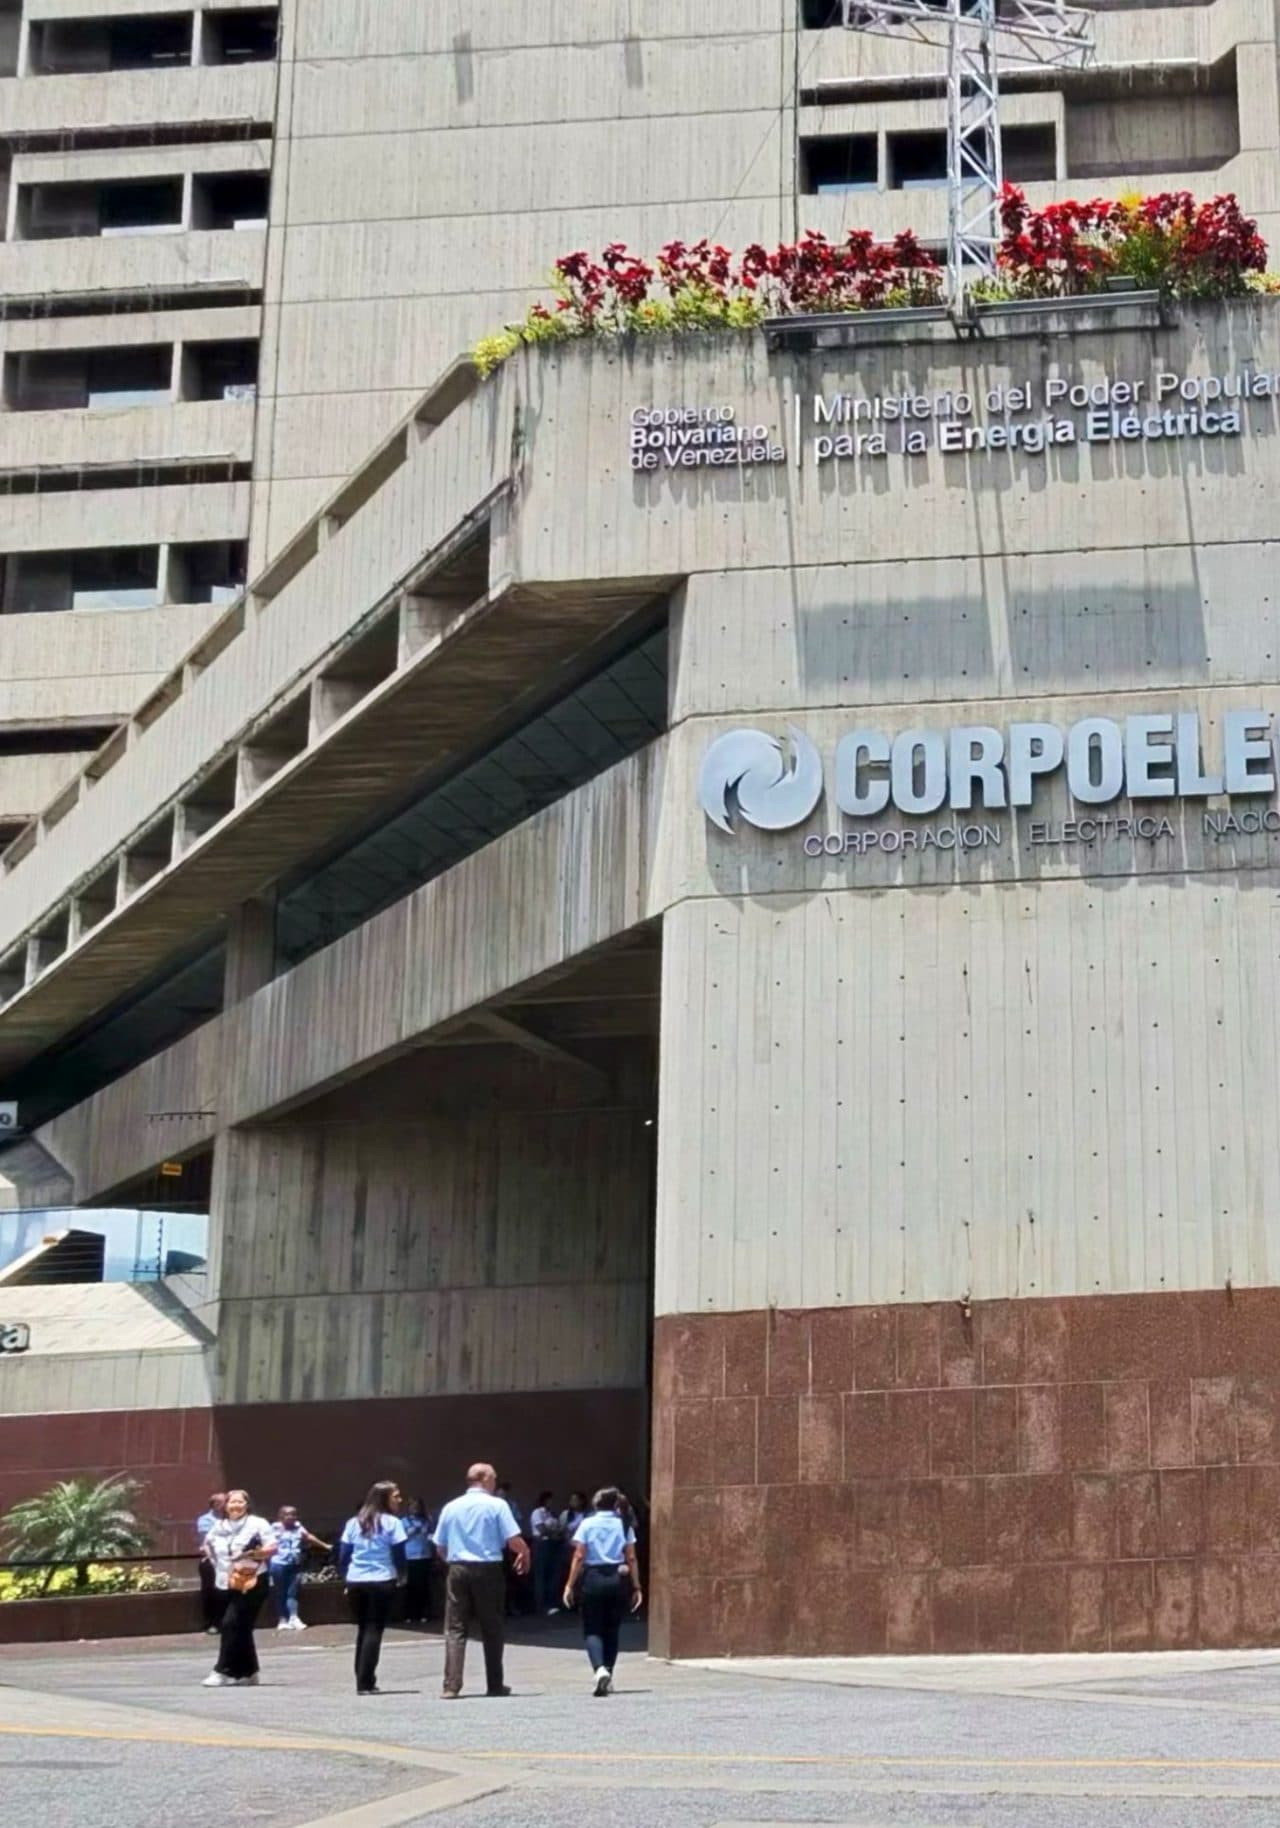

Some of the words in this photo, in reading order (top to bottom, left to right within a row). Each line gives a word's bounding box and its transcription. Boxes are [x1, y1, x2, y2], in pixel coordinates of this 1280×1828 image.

[813, 388, 973, 424] Ministerio
[986, 379, 1032, 413] del
[1045, 374, 1145, 408] Poder
[630, 422, 769, 449] Bolivariano
[630, 447, 658, 470] de
[663, 440, 786, 468] Venezuela
[814, 431, 887, 465] para
[899, 420, 927, 454] la
[939, 410, 1075, 452] Energía
[1086, 406, 1241, 441] Eléctrica
[803, 822, 1001, 857] CORPORACION
[1028, 814, 1176, 846] ELECTRICA
